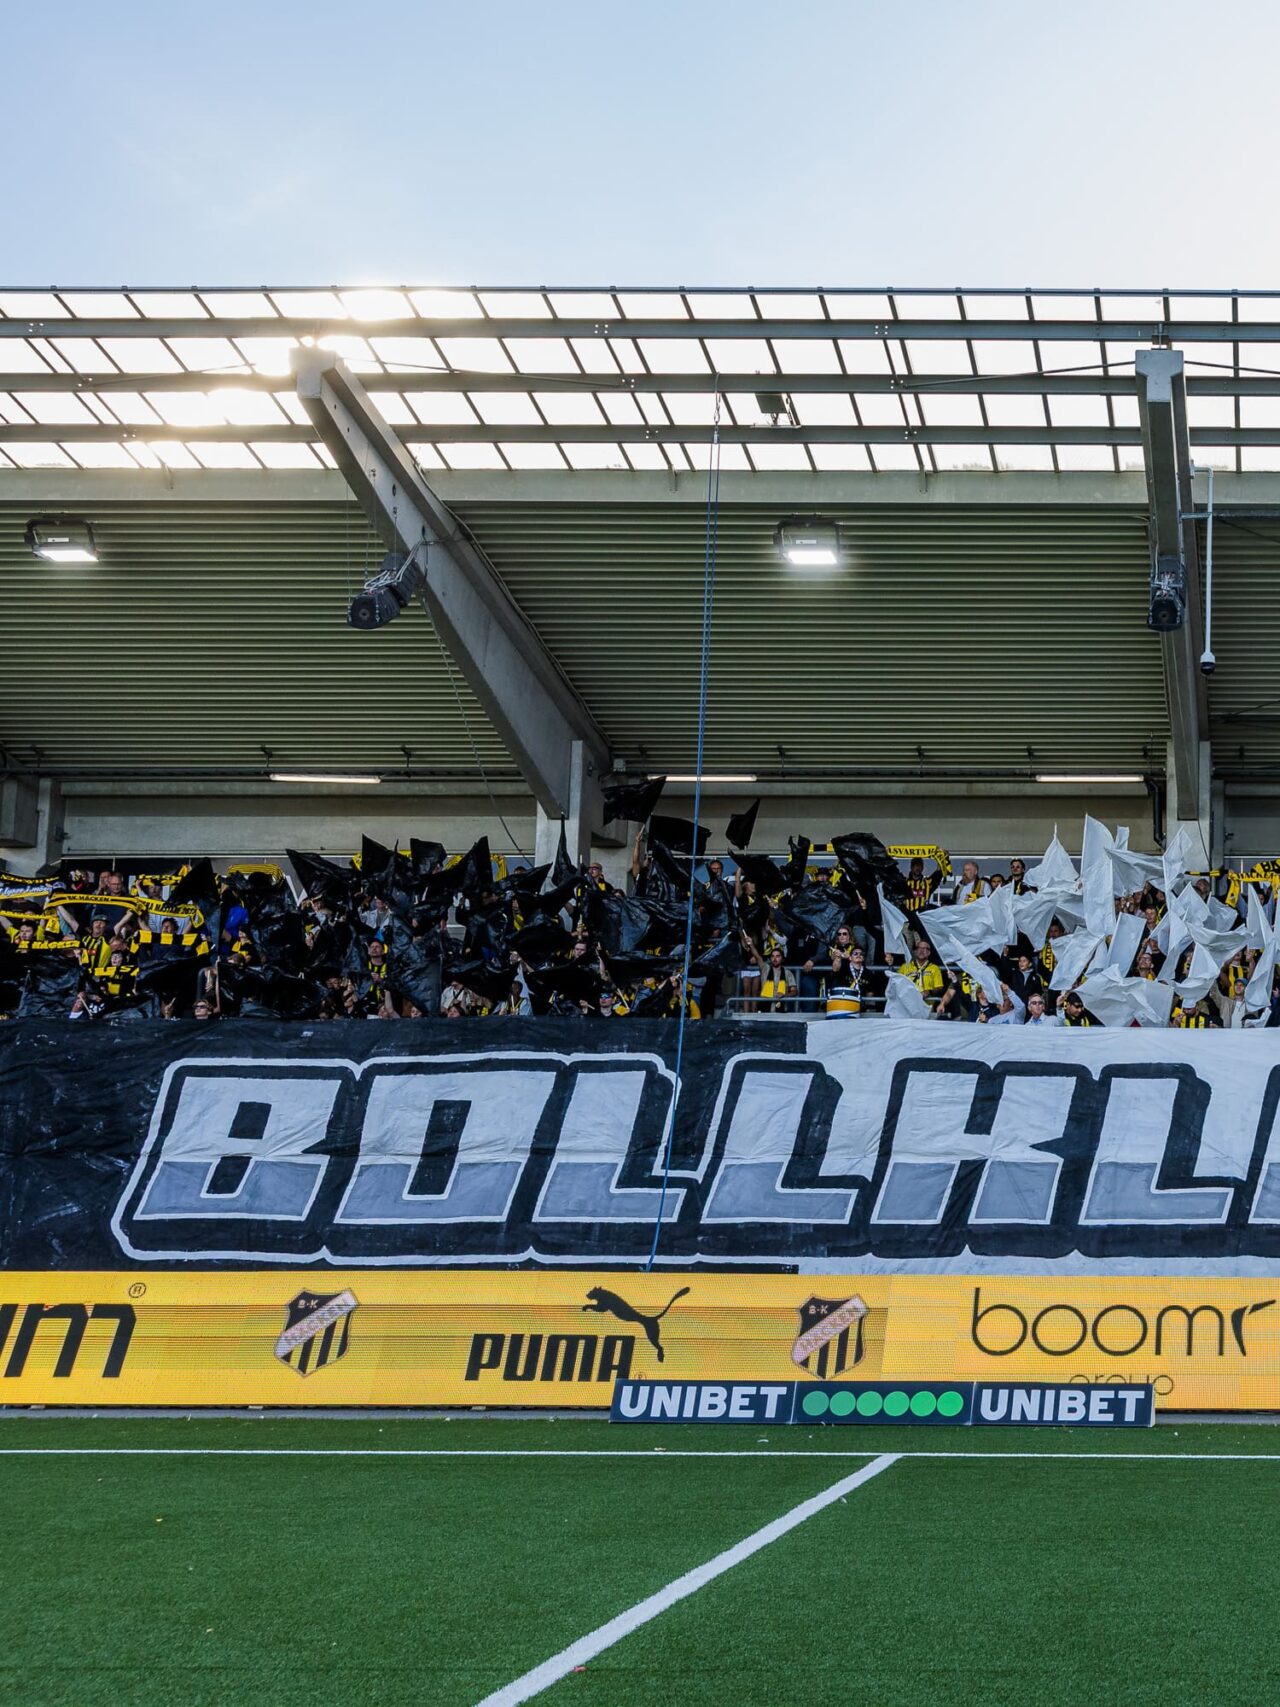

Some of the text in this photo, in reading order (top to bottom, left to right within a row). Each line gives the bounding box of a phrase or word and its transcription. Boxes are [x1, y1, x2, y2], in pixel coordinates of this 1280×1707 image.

[972, 1287, 1276, 1356] boomr
[464, 1333, 636, 1382] PUMA
[619, 1385, 787, 1418] UNIBET
[980, 1388, 1145, 1422] UNIBET
